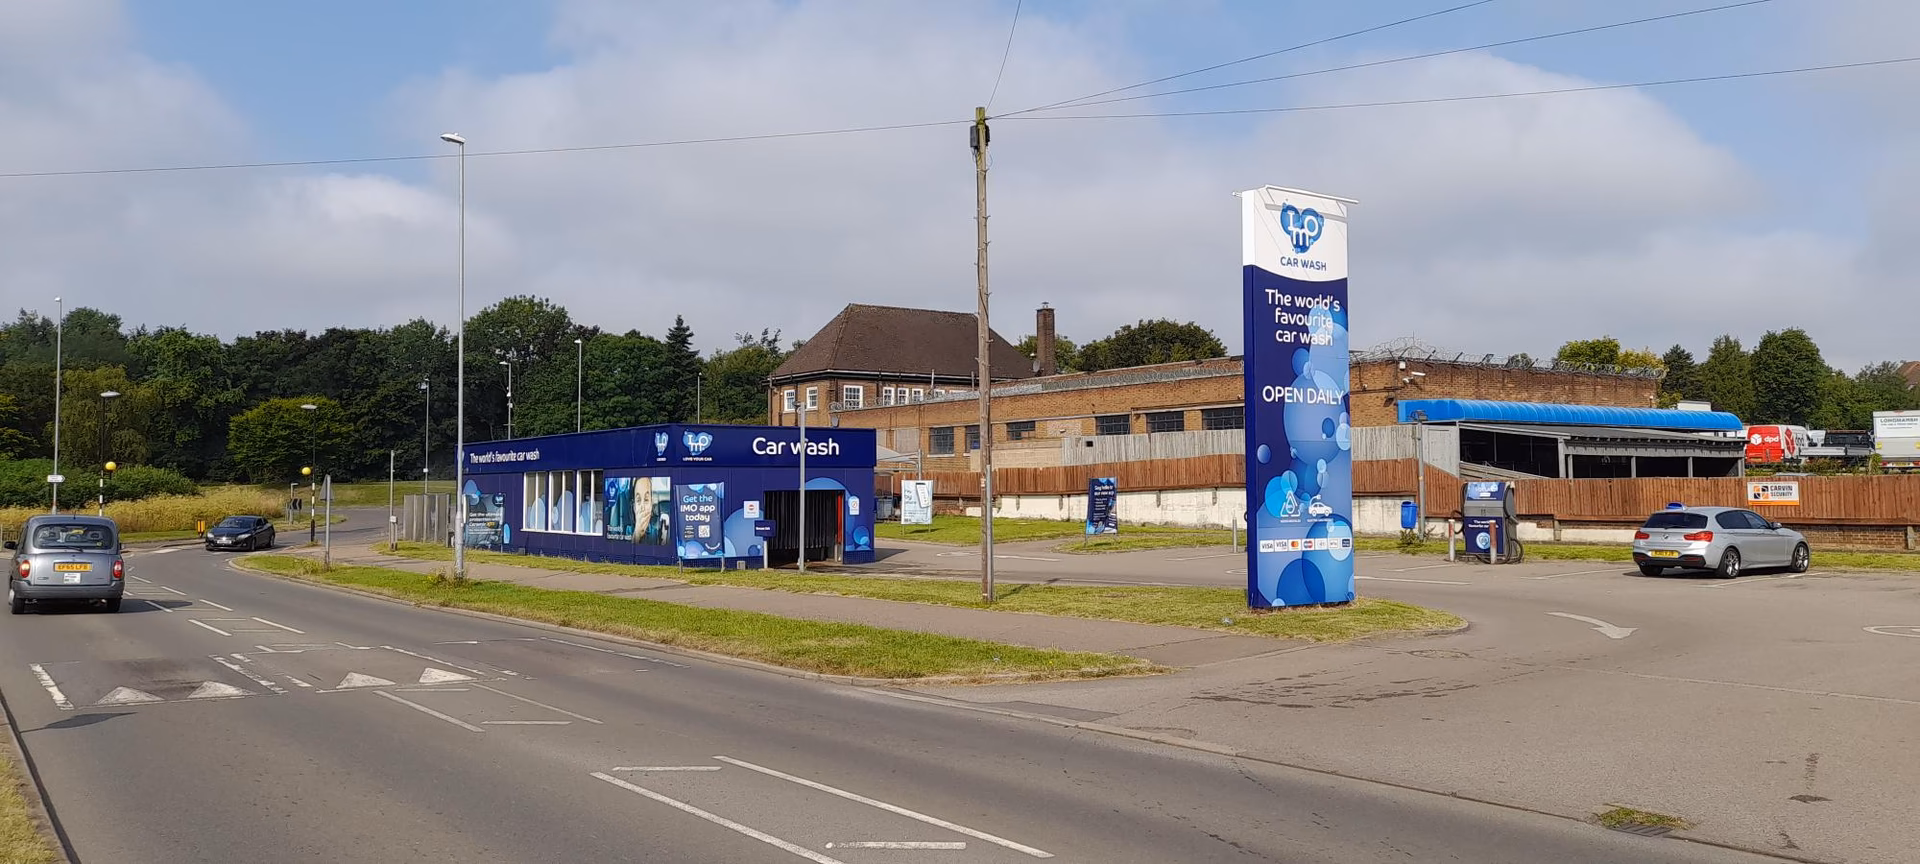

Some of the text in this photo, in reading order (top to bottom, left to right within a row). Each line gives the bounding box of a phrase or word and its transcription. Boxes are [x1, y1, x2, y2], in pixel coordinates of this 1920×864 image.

[1280, 256, 1327, 271] CAR WASH
[1265, 288, 1341, 312] The world's
[1275, 308, 1334, 328] favourite
[1275, 329, 1334, 347] car wash
[1262, 385, 1345, 405] OPEN DAILY
[752, 436, 840, 456] Car wash
[1764, 435, 1779, 443] dpd
[470, 448, 540, 464] The world's favourite car wash
[683, 495, 698, 503] Get
[680, 504, 716, 513] IMO app
[685, 513, 710, 523] today
[1262, 542, 1273, 550] VISA
